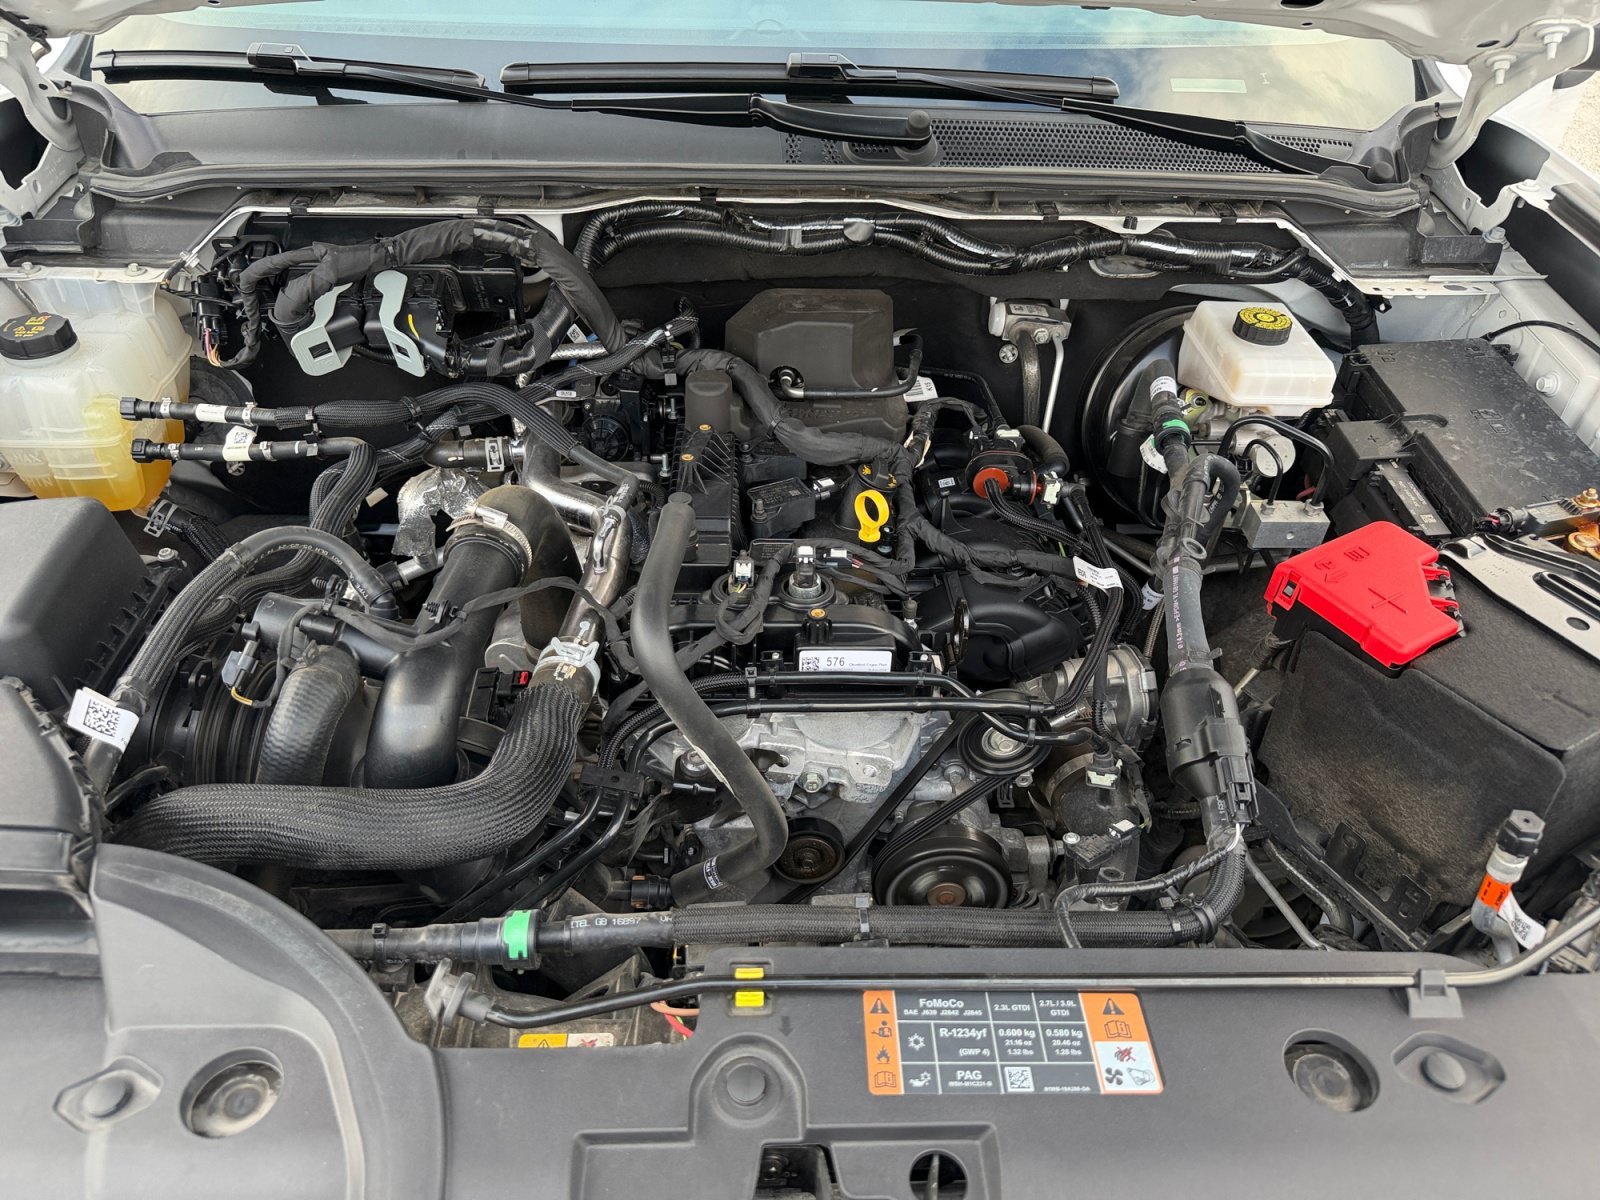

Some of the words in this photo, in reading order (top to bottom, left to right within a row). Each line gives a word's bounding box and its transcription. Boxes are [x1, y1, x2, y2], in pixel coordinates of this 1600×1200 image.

[826, 656, 845, 667] 576
[919, 998, 964, 1008] FoMoCo
[939, 1027, 987, 1040] R-1234yf
[998, 1028, 1022, 1037] 0.600
[1023, 1028, 1036, 1038] kg
[1046, 1028, 1070, 1037] 0.580
[1071, 1029, 1083, 1039] kg
[959, 1048, 981, 1056] (GWP
[982, 1048, 990, 1056] 4)
[956, 1070, 982, 1080] PAG
